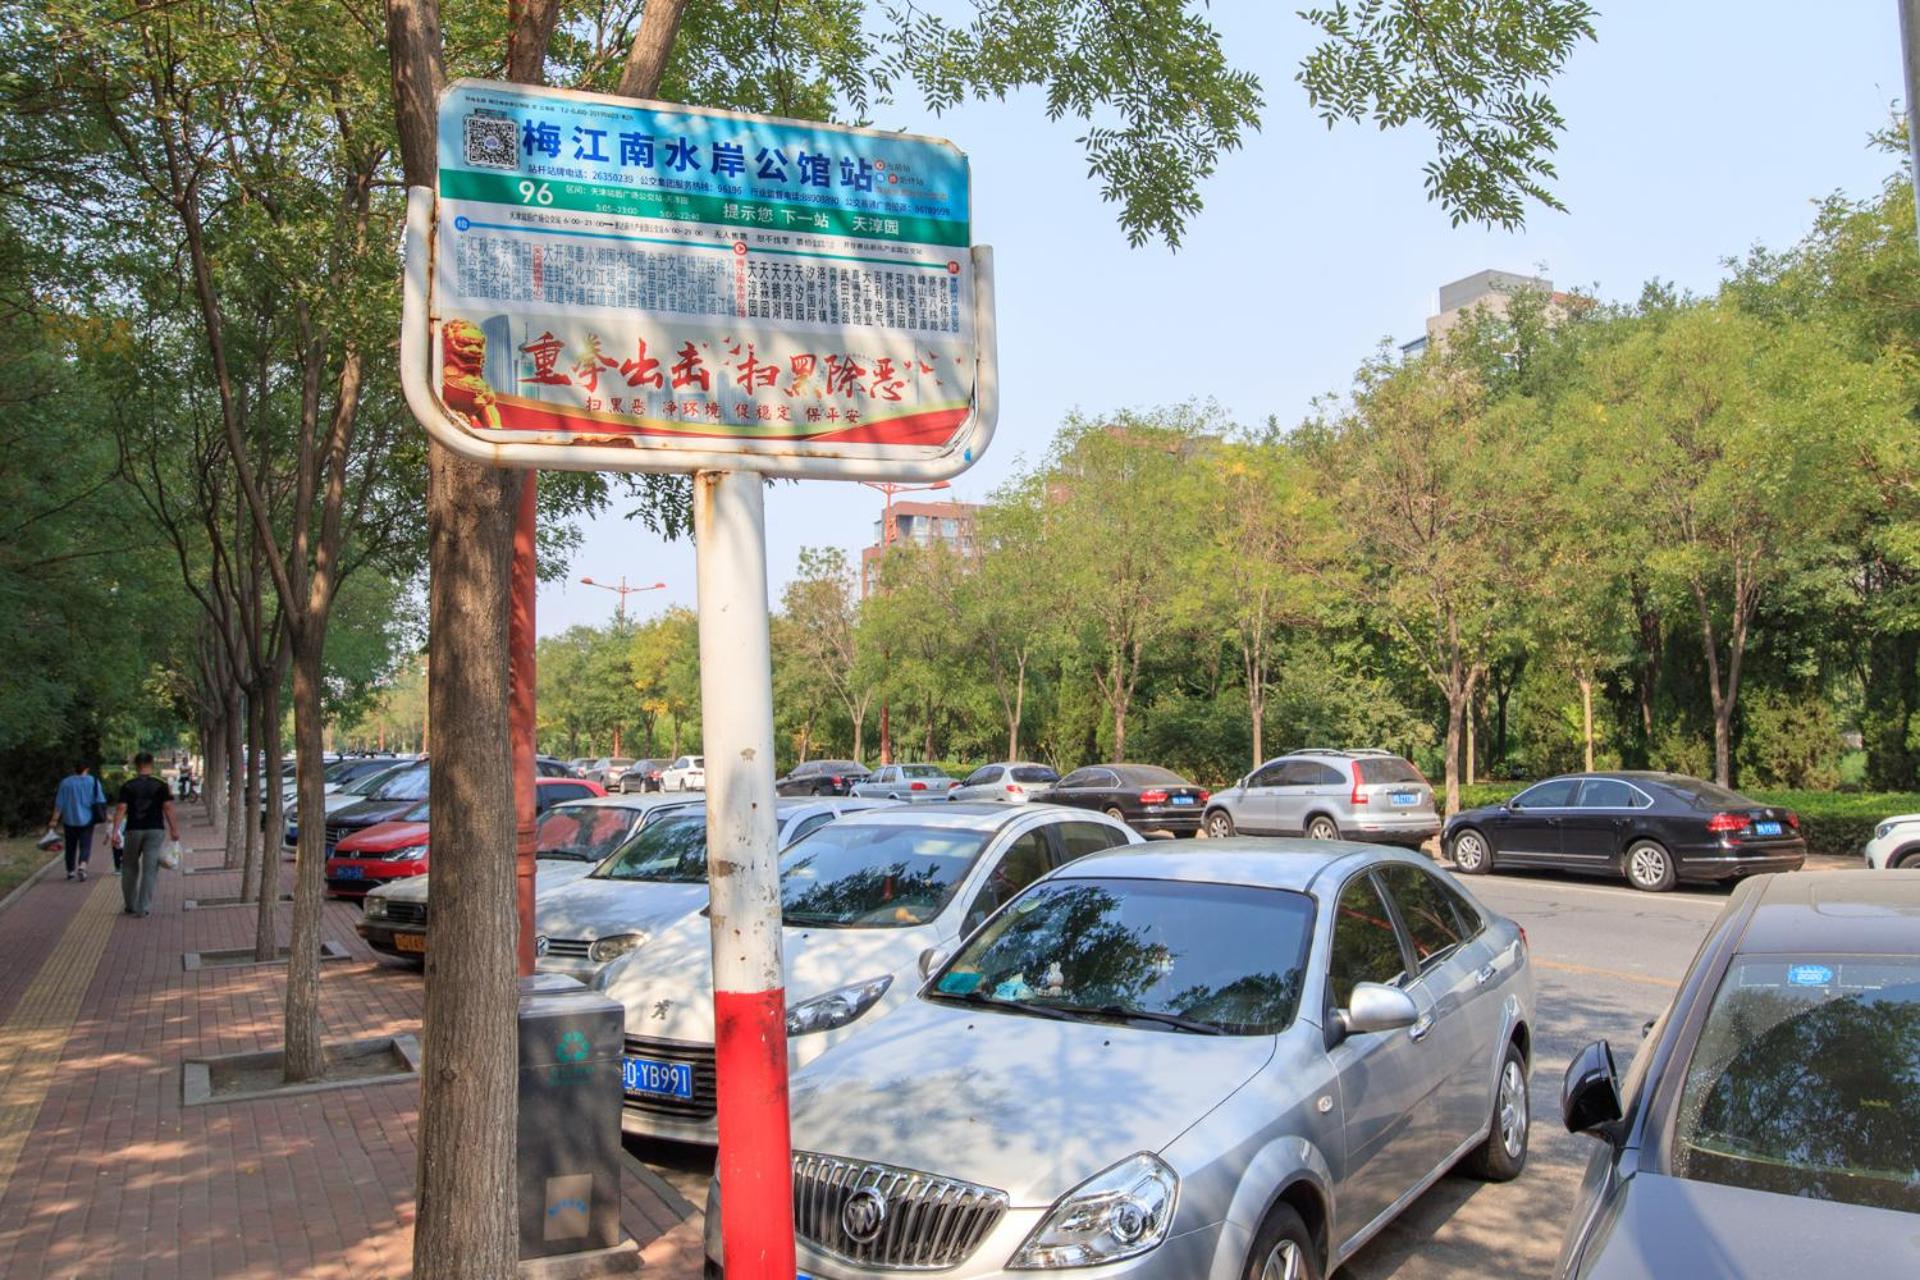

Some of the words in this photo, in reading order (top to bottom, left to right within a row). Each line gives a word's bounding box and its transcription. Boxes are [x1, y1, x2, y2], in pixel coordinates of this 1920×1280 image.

[523, 118, 873, 193] 梅江南水岸公馆站
[518, 180, 554, 205] 96
[723, 202, 772, 222] 提示您
[781, 209, 829, 229] 下一站
[852, 216, 899, 236] 天淳园
[748, 261, 758, 317] 天淳园
[518, 330, 710, 394] 重拳出击
[736, 351, 908, 401] 扫黑除恶
[585, 398, 646, 416] 扫黑恶
[662, 401, 722, 420] 净环境
[736, 404, 792, 422] 促稳定
[806, 407, 860, 425] 保平安
